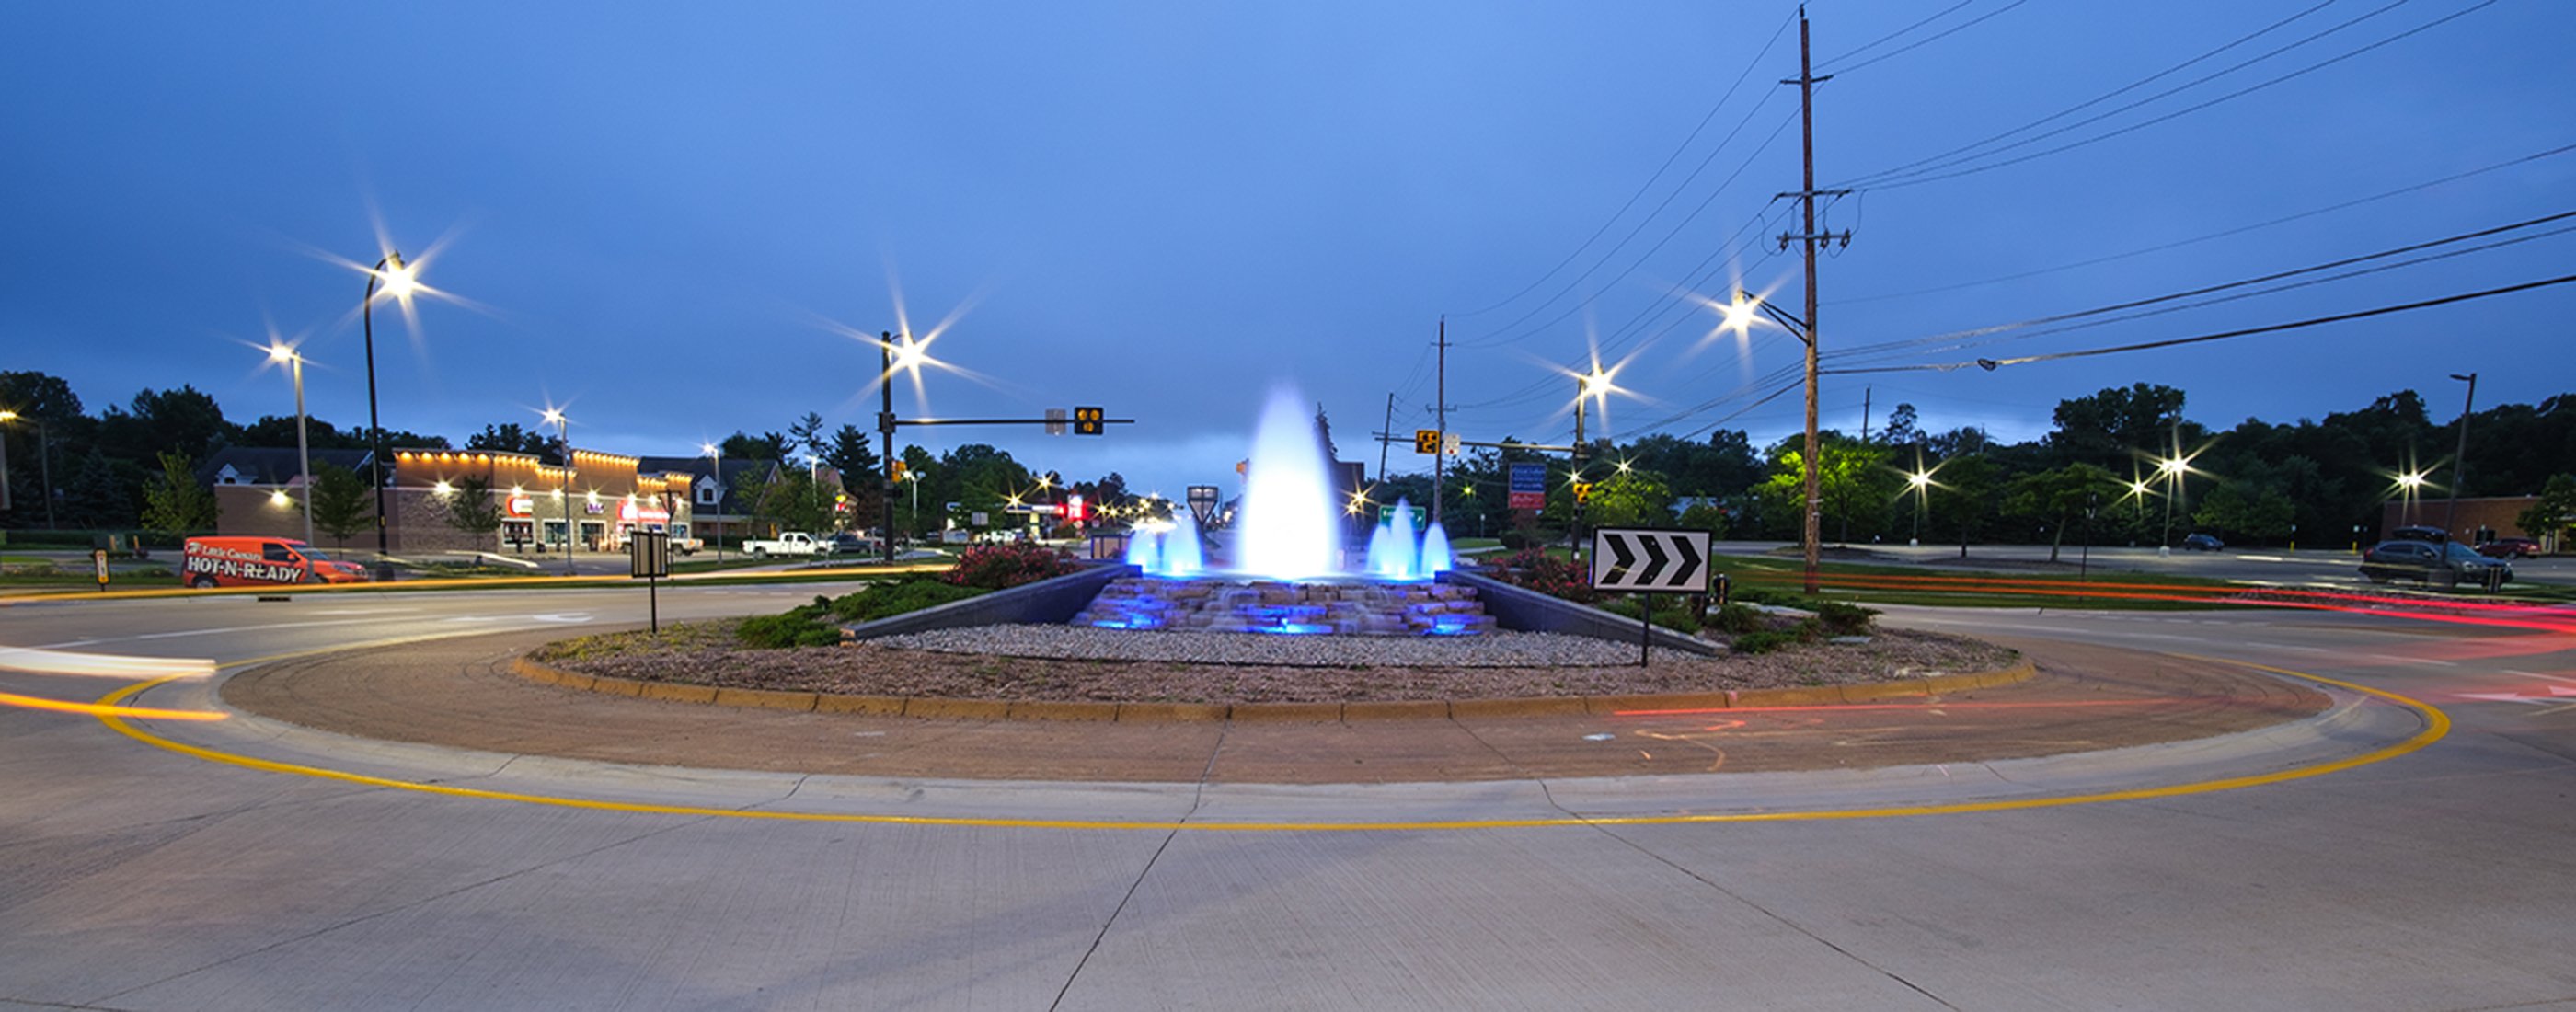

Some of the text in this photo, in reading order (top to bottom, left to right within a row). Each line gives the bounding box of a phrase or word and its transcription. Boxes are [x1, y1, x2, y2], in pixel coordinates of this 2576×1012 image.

[201, 546, 262, 561] Little Caesars
[187, 556, 302, 583] HOT-N-READY
